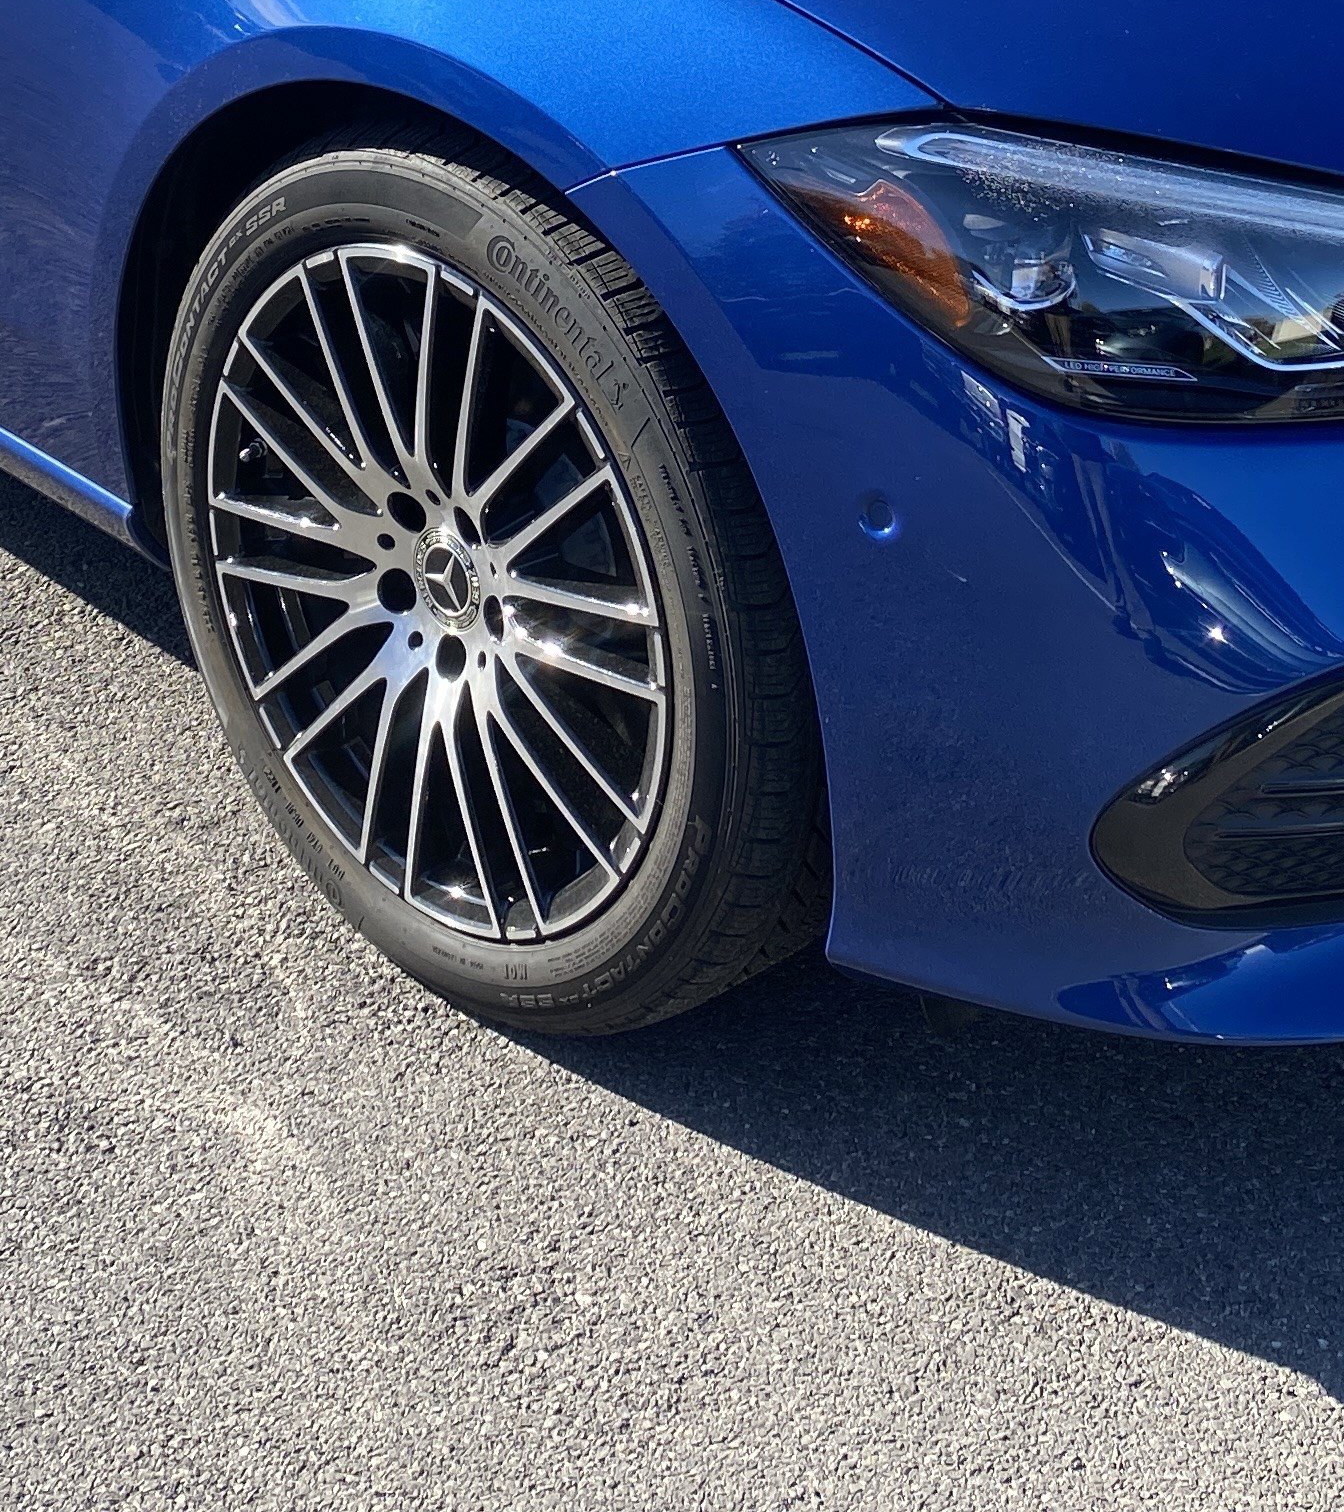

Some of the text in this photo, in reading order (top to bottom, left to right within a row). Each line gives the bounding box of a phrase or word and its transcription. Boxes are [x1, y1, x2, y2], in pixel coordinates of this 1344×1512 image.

[245, 196, 288, 236] SSR
[486, 234, 615, 382] Continental
[1064, 360, 1083, 371] LED
